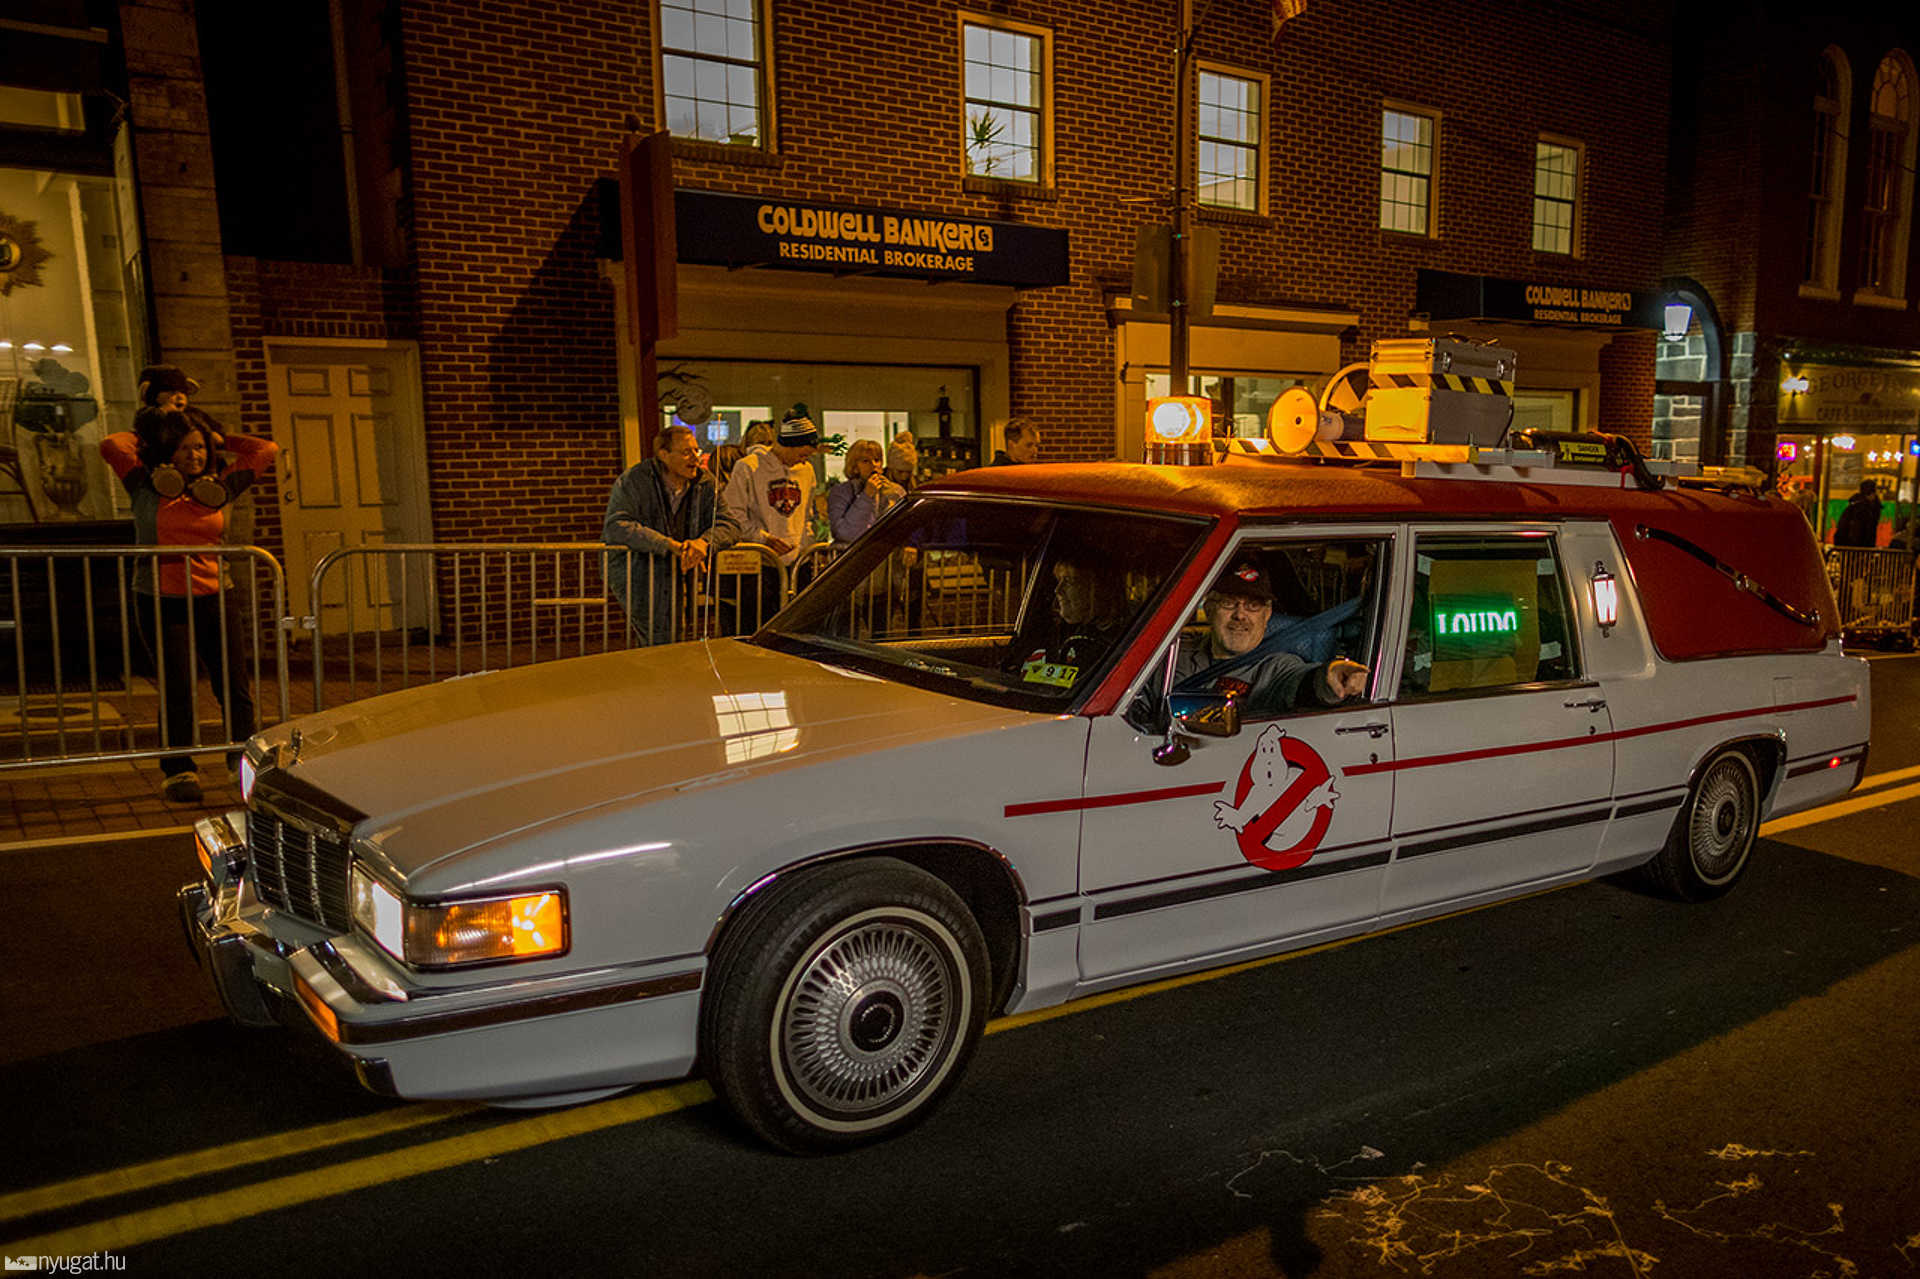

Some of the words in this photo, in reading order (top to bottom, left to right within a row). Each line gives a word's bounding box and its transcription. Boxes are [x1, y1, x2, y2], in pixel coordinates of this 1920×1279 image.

[757, 204, 881, 243] COLDWELL
[883, 215, 974, 254] BANKER
[779, 241, 879, 265] RESIDENTIAL
[884, 253, 975, 273] BROKERAGE
